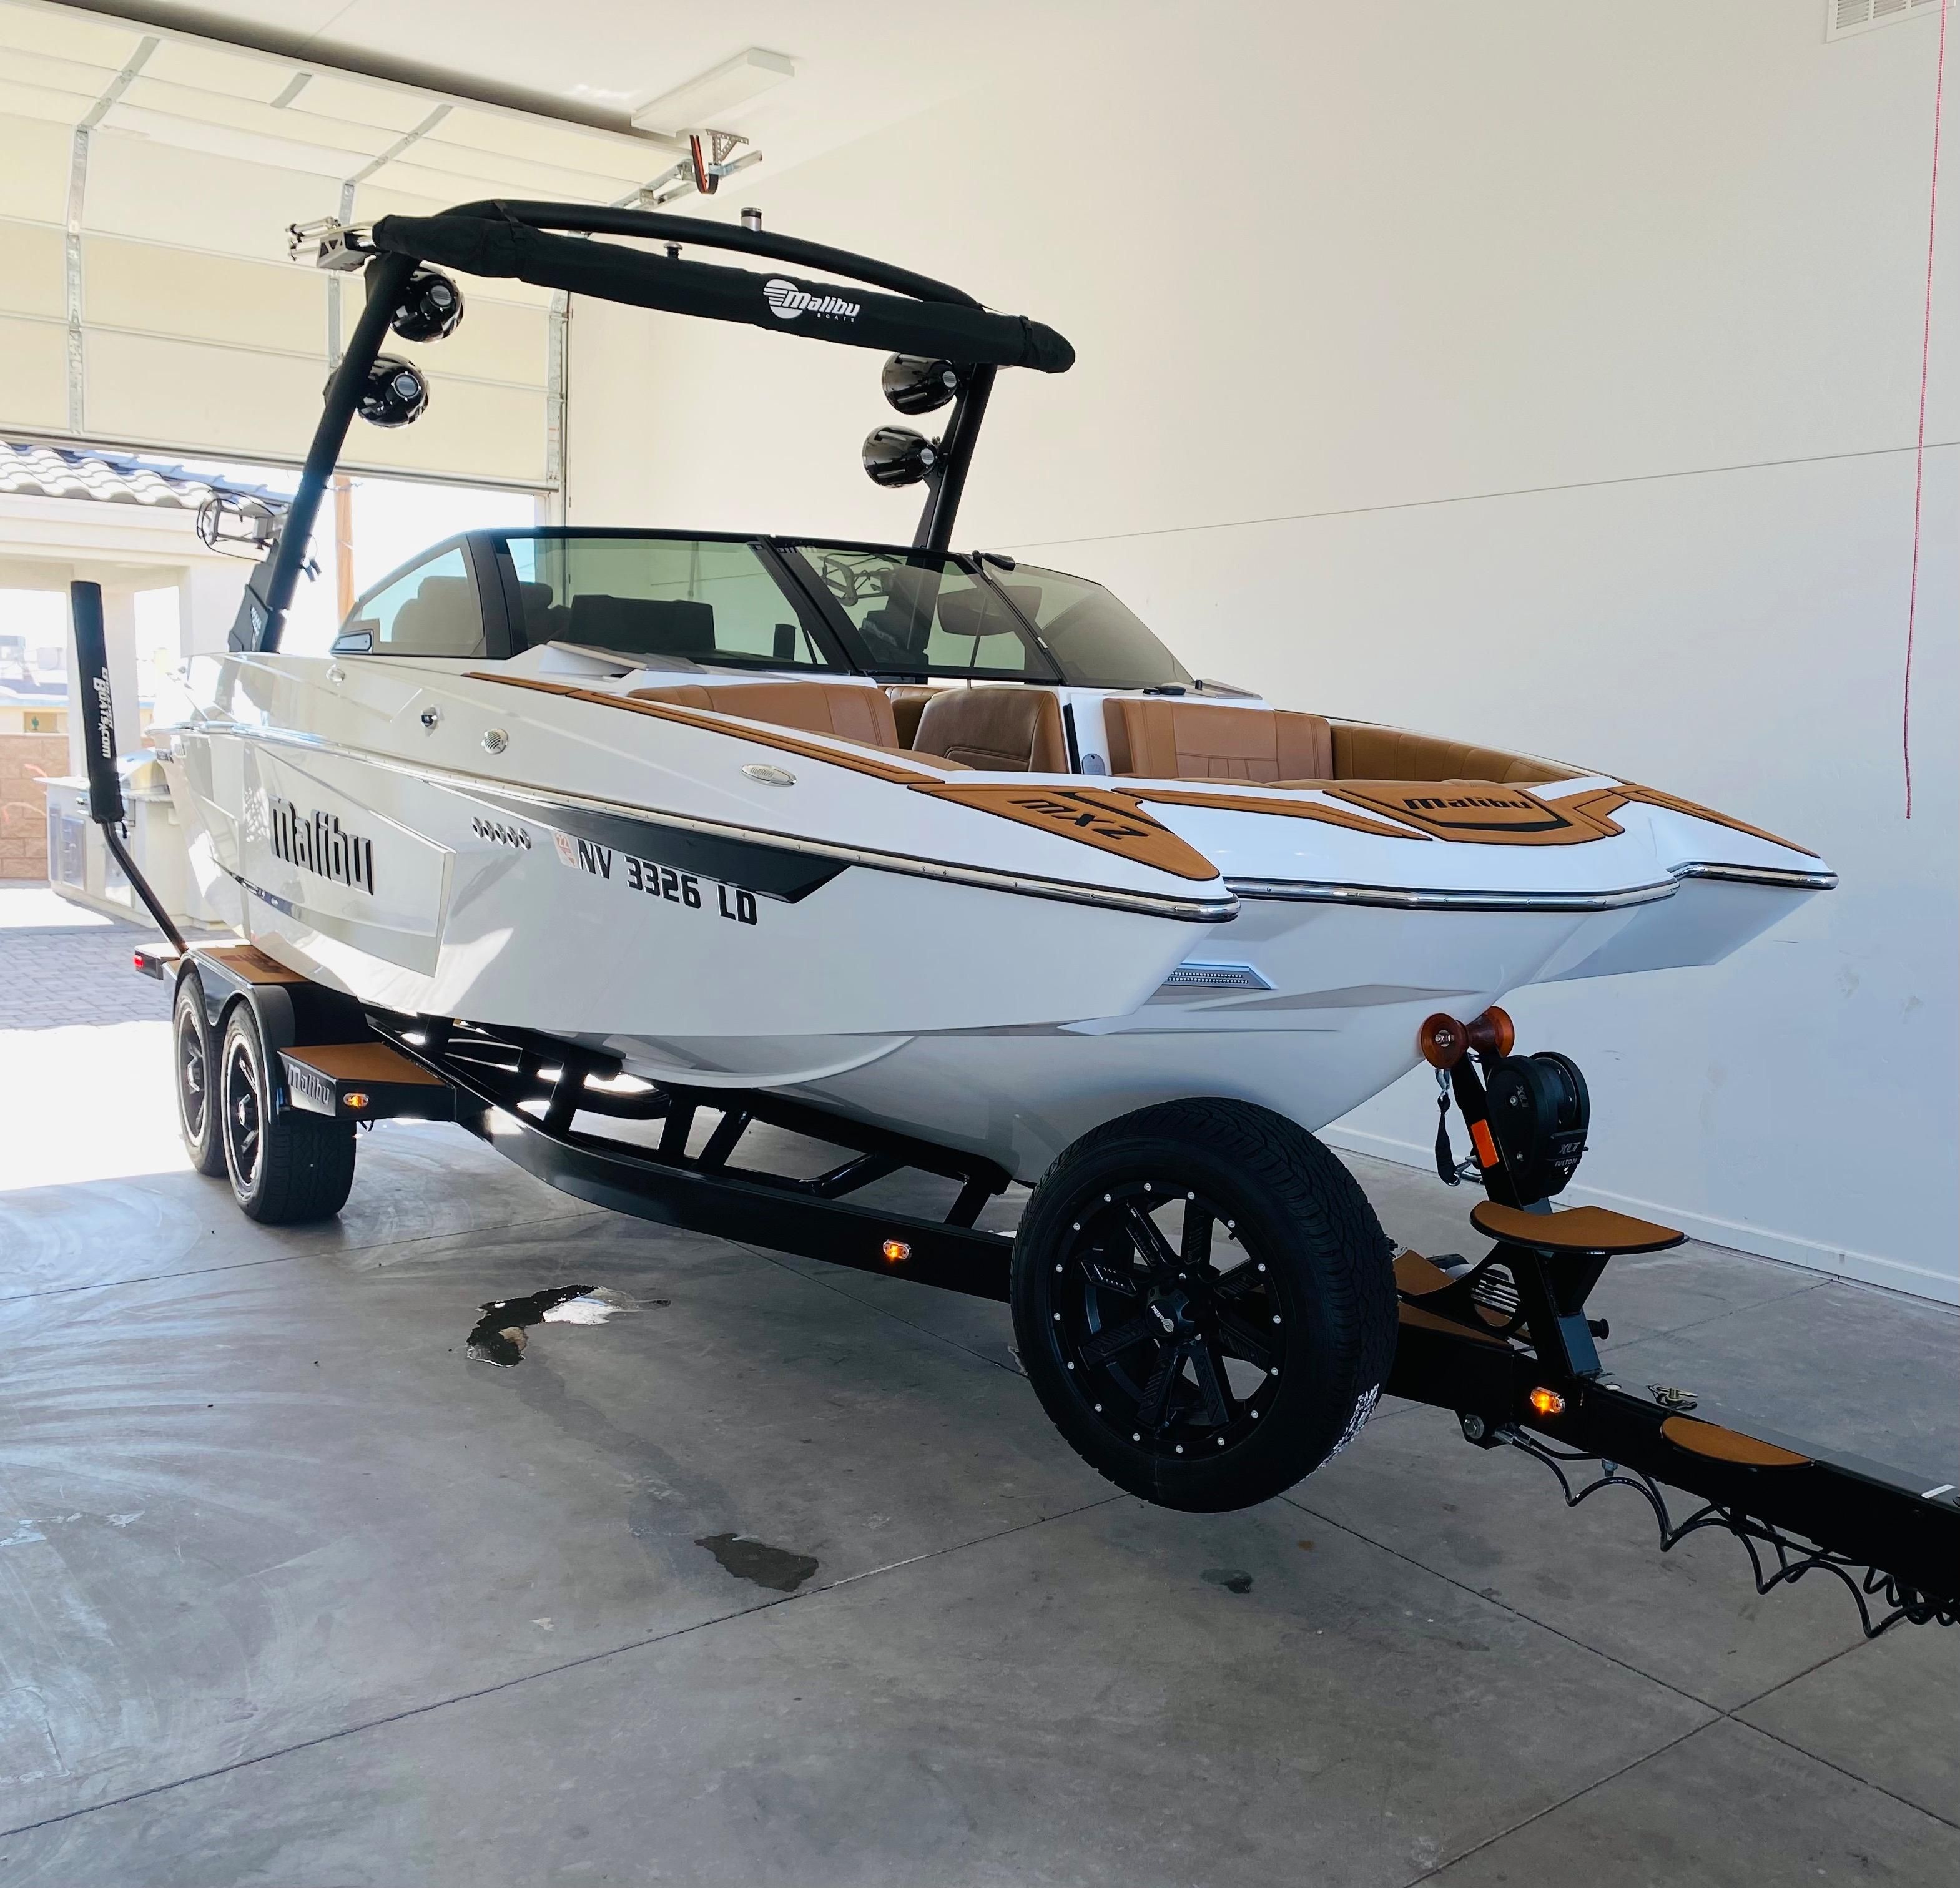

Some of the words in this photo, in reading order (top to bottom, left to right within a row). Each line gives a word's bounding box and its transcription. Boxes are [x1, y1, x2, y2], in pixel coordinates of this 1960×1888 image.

[782, 290, 860, 317] Malibu
[817, 312, 854, 323] BOATS
[1402, 796, 1533, 810] Malibu
[268, 794, 373, 895] Malibu
[577, 838, 611, 880] NV
[624, 855, 701, 910] 3326
[716, 883, 757, 925] LD
[287, 1063, 330, 1106] Malibu
[1558, 1141, 1582, 1154] XLT
